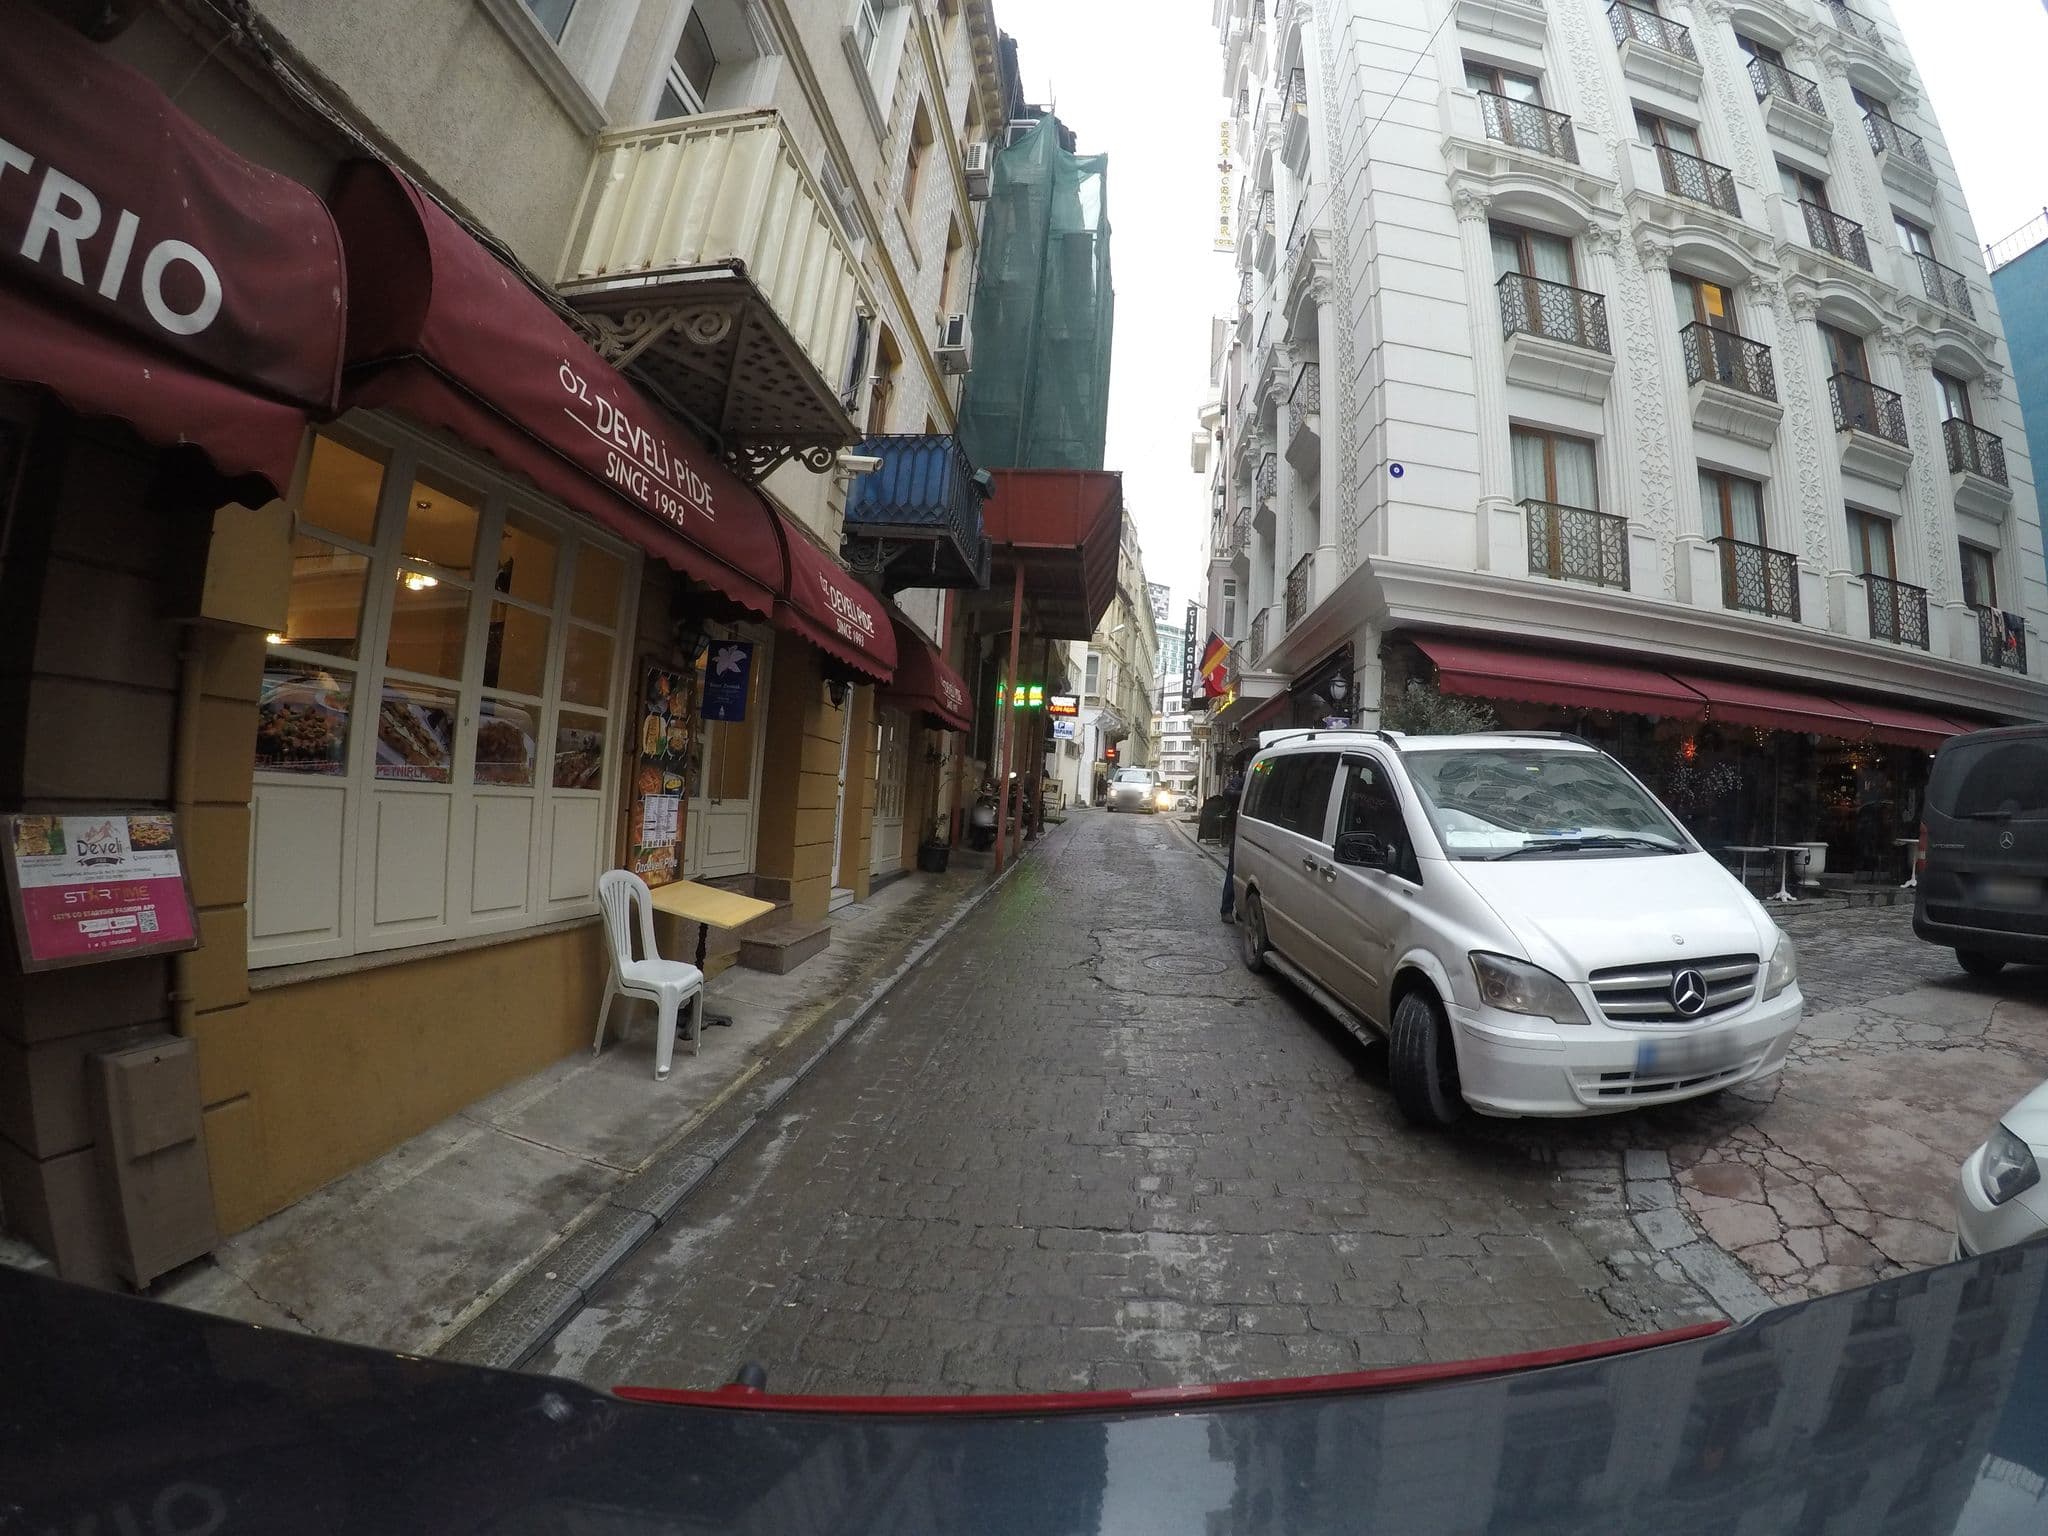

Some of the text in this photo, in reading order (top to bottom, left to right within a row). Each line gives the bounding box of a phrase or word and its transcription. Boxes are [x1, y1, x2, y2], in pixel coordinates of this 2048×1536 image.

[559, 359, 592, 406] ÖZ
[673, 458, 715, 514] PİDE
[606, 451, 684, 526] SINCE 1993
[837, 618, 865, 647] SINCE 1993
[1188, 609, 1196, 643] city
[77, 838, 123, 857] Develi
